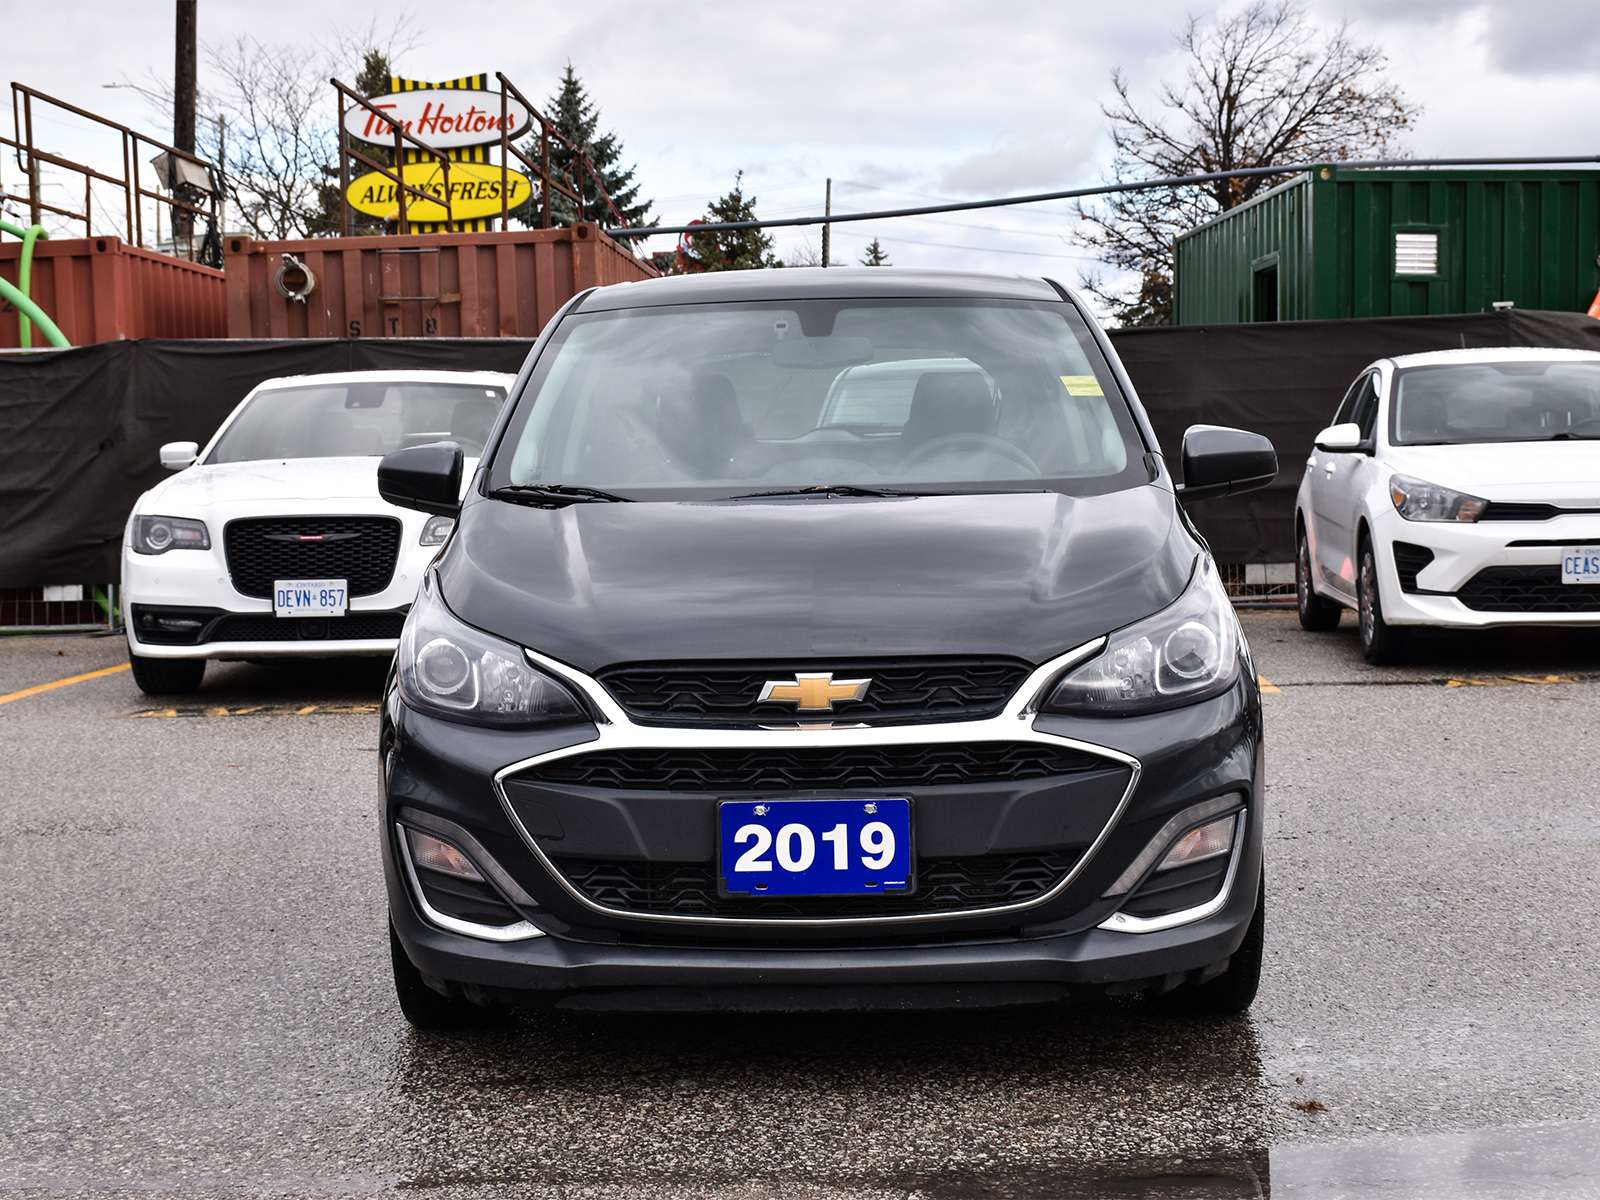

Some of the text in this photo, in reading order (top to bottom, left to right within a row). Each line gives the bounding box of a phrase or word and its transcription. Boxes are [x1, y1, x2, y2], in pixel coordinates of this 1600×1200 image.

[417, 102, 514, 134] Hortons
[449, 180, 518, 200] FRESH
[1565, 557, 1600, 574] CEAS
[278, 589, 344, 607] DEVN 857
[734, 822, 896, 872] 2019
